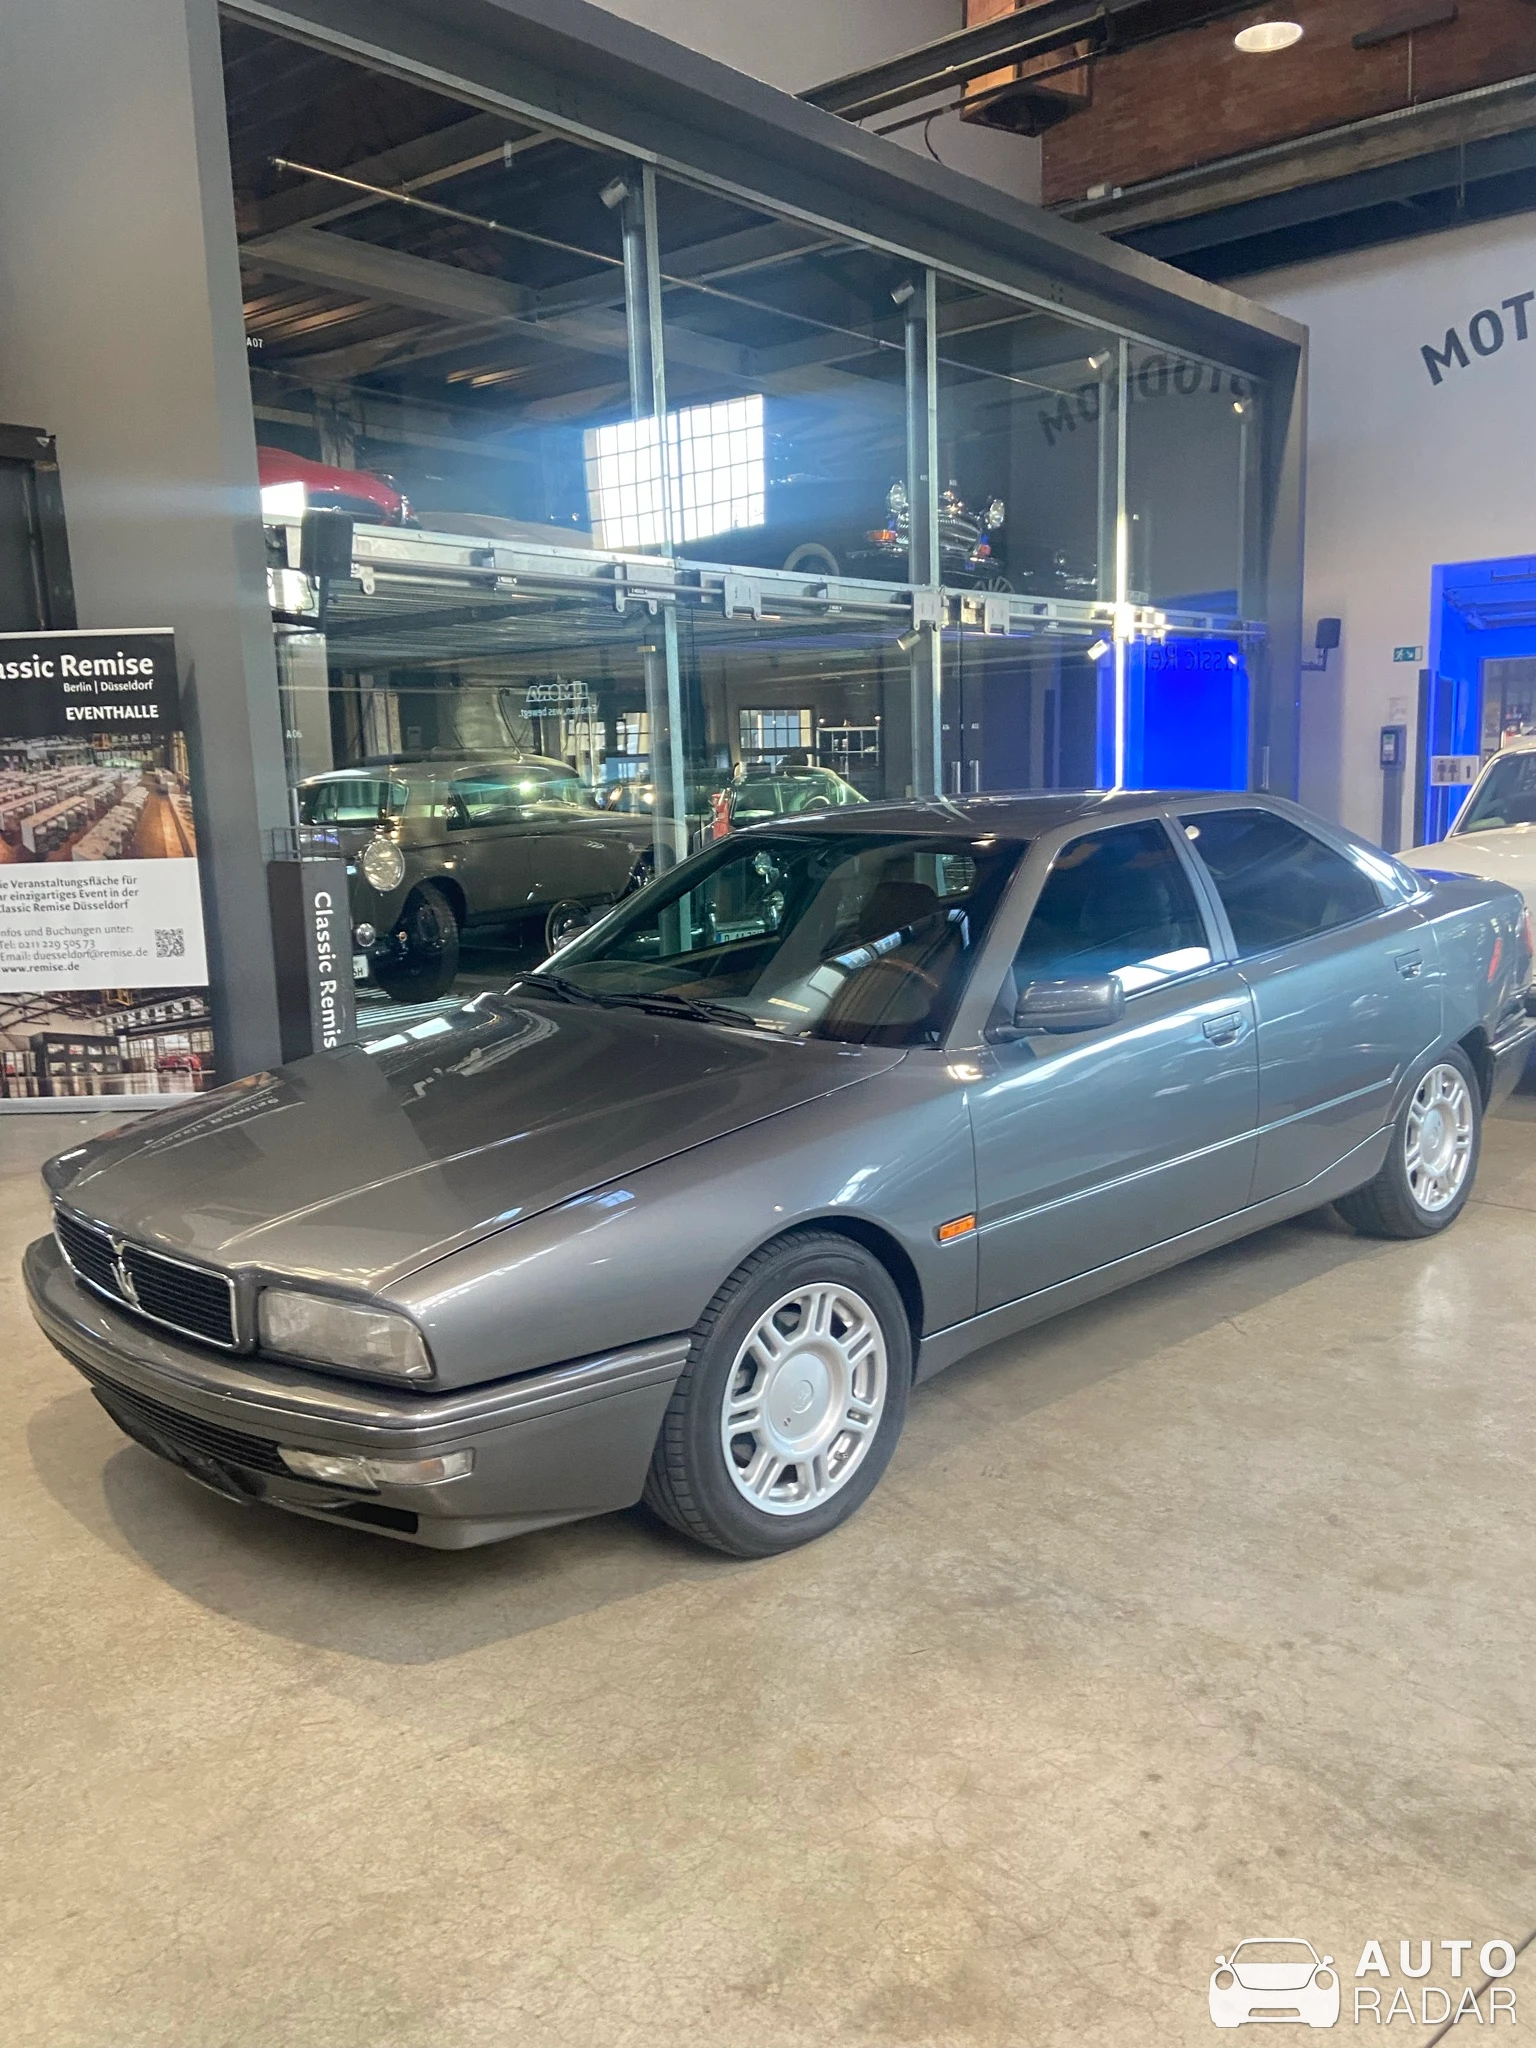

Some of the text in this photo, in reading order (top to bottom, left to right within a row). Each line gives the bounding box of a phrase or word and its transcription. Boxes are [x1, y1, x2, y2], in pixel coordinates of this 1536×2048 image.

[246, 337, 263, 348] A07
[1420, 290, 1535, 386] MOT
[60, 651, 154, 678] Remise
[64, 682, 92, 692] Berlin
[100, 679, 154, 692] Düsseldorf
[66, 705, 159, 721] EVENTHALLE
[10, 875, 119, 889] Veranstaltungsfläche
[121, 875, 138, 885] für
[10, 890, 77, 902] einzigartiges
[79, 889, 108, 898] Event
[109, 887, 119, 897] in
[121, 886, 139, 897] der
[33, 901, 71, 912] Remise
[73, 899, 130, 911] Düsseldorf
[24, 926, 43, 936] und
[45, 926, 102, 937] Buchungen
[104, 925, 134, 934] unter:
[314, 891, 337, 974] Classic
[82, 939, 96, 949] 73
[33, 946, 149, 961] duesseldorf@remise.de
[0, 961, 80, 973] www.remise.de
